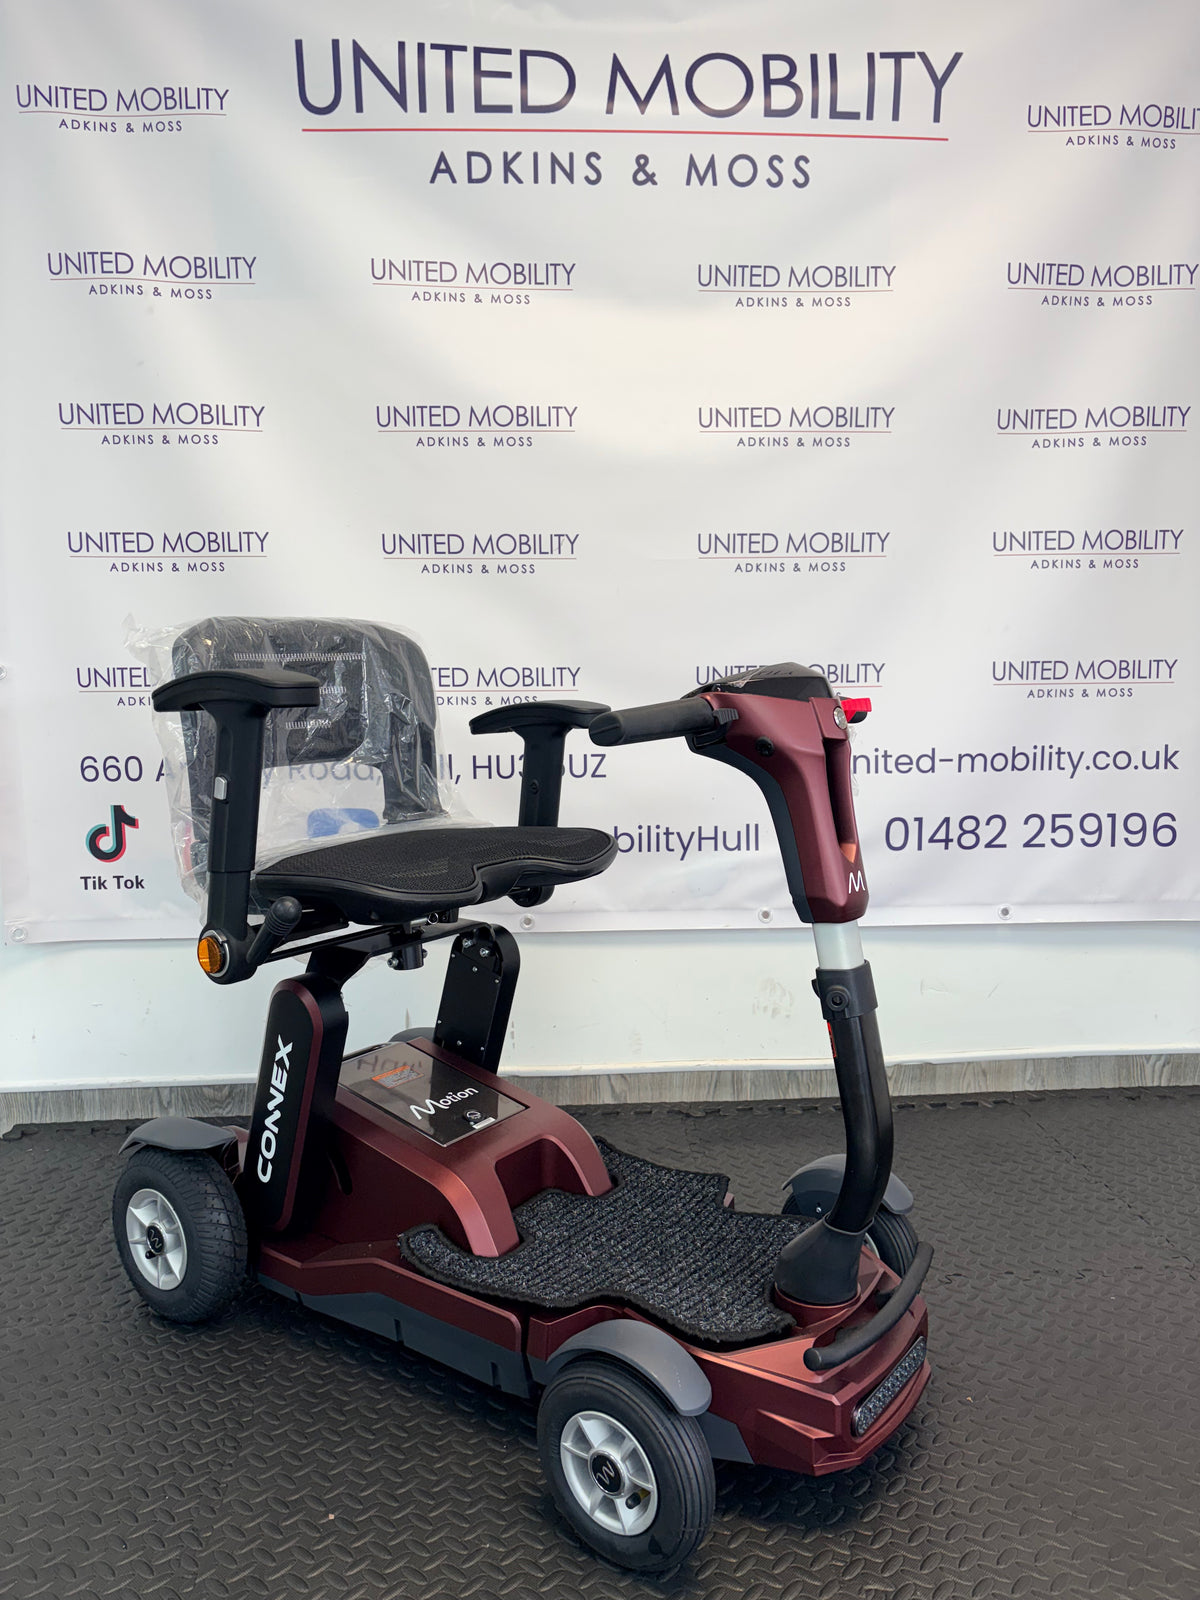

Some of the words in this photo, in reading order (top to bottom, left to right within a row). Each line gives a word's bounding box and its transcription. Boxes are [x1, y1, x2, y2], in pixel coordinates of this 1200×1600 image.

[295, 38, 576, 116] UNITED
[605, 51, 964, 123] MOBILITY
[16, 84, 107, 111] UNITED
[116, 87, 229, 111] MOBILITY
[59, 118, 117, 133] ADKINS
[126, 122, 135, 133] &
[143, 120, 182, 132] MOSS
[1028, 105, 1111, 128] UNITED
[1120, 104, 1200, 130] MOBILI
[1066, 135, 1119, 146] ADKINS
[1126, 136, 1134, 146] &
[1141, 136, 1176, 149] MOSS
[429, 151, 602, 186] ADKINS
[632, 154, 658, 186] &
[685, 153, 810, 189] MOSS
[48, 251, 134, 276] UNITED
[143, 254, 256, 279] MOBILITY
[371, 258, 457, 283] UNITED
[465, 262, 576, 286] MOBILITY
[698, 264, 780, 287] UNITED
[788, 265, 895, 288] MOBILITY
[1008, 262, 1084, 286] UNITED
[1091, 264, 1199, 287] MOBILITY
[89, 284, 143, 295] ADKINS
[153, 287, 162, 297] &
[171, 288, 212, 300] MOSS
[411, 291, 464, 302] ADKINS
[474, 293, 482, 303] &
[491, 294, 530, 304] MOSS
[735, 297, 787, 307] ADKINS
[796, 298, 804, 307] &
[812, 297, 850, 307] MOSS
[1041, 295, 1089, 307] ADKINS
[1097, 297, 1105, 307] &
[1113, 295, 1152, 306] MOSS
[58, 403, 144, 425] UNITED
[152, 402, 265, 427] MOBILITY
[376, 405, 460, 428] UNITED
[468, 405, 578, 427] MOBILITY
[699, 407, 781, 428] UNITED
[789, 406, 895, 428] MOBILITY
[997, 409, 1077, 430] UNITED
[1085, 406, 1191, 428] MOBILITY
[101, 434, 154, 445] ADKINS
[162, 432, 171, 445] &
[178, 434, 218, 445] MOSS
[416, 436, 469, 447] ADKINS
[477, 437, 486, 447] &
[493, 436, 532, 447] MOSS
[737, 436, 789, 447] ADKINS
[796, 437, 805, 447] &
[812, 437, 850, 447] MOSS
[1032, 437, 1084, 448] ADKINS
[1093, 437, 1101, 446] &
[1109, 436, 1146, 446] MOSS
[68, 531, 154, 553] UNITED
[162, 531, 269, 553] MOBILITY
[382, 533, 464, 555] UNITED
[472, 533, 579, 555] MOBILITY
[698, 533, 779, 554] UNITED
[786, 532, 890, 553] MOBILITY
[993, 530, 1075, 552] UNITED
[1082, 529, 1184, 550] MOBILITY
[110, 561, 163, 572] ADKINS
[171, 562, 180, 572] &
[187, 562, 225, 572] MOSS
[421, 564, 473, 574] ADKINS
[481, 564, 489, 575] &
[497, 564, 535, 574] MOSS
[734, 562, 785, 573] ADKINS
[793, 563, 801, 572] &
[808, 562, 845, 572] MOSS
[1031, 559, 1081, 569] ADKINS
[1088, 559, 1096, 569] &
[1103, 559, 1138, 568] MOSS
[477, 667, 581, 687] MOBILITY
[697, 666, 756, 686] UNIT
[993, 660, 1069, 681] UNITED
[1075, 659, 1178, 680] MOBILITY
[117, 697, 151, 706] ADKI
[437, 696, 477, 706] DKINS
[485, 696, 493, 706] &
[501, 695, 538, 705] MOSS
[1027, 688, 1074, 698] ADKINS
[1081, 689, 1089, 698] &
[1096, 688, 1133, 697] MOSS
[80, 756, 143, 782] 660
[561, 754, 607, 779] UZ
[853, 744, 1180, 779] nited-mobility.co.uk
[613, 823, 760, 861] bilityHull
[885, 814, 1007, 851] 01482
[1022, 812, 1177, 848] 259196
[80, 876, 108, 890] Tik
[113, 875, 145, 890] Tok
[257, 1034, 293, 1183] CONNEX
[410, 1087, 479, 1120] Motion
